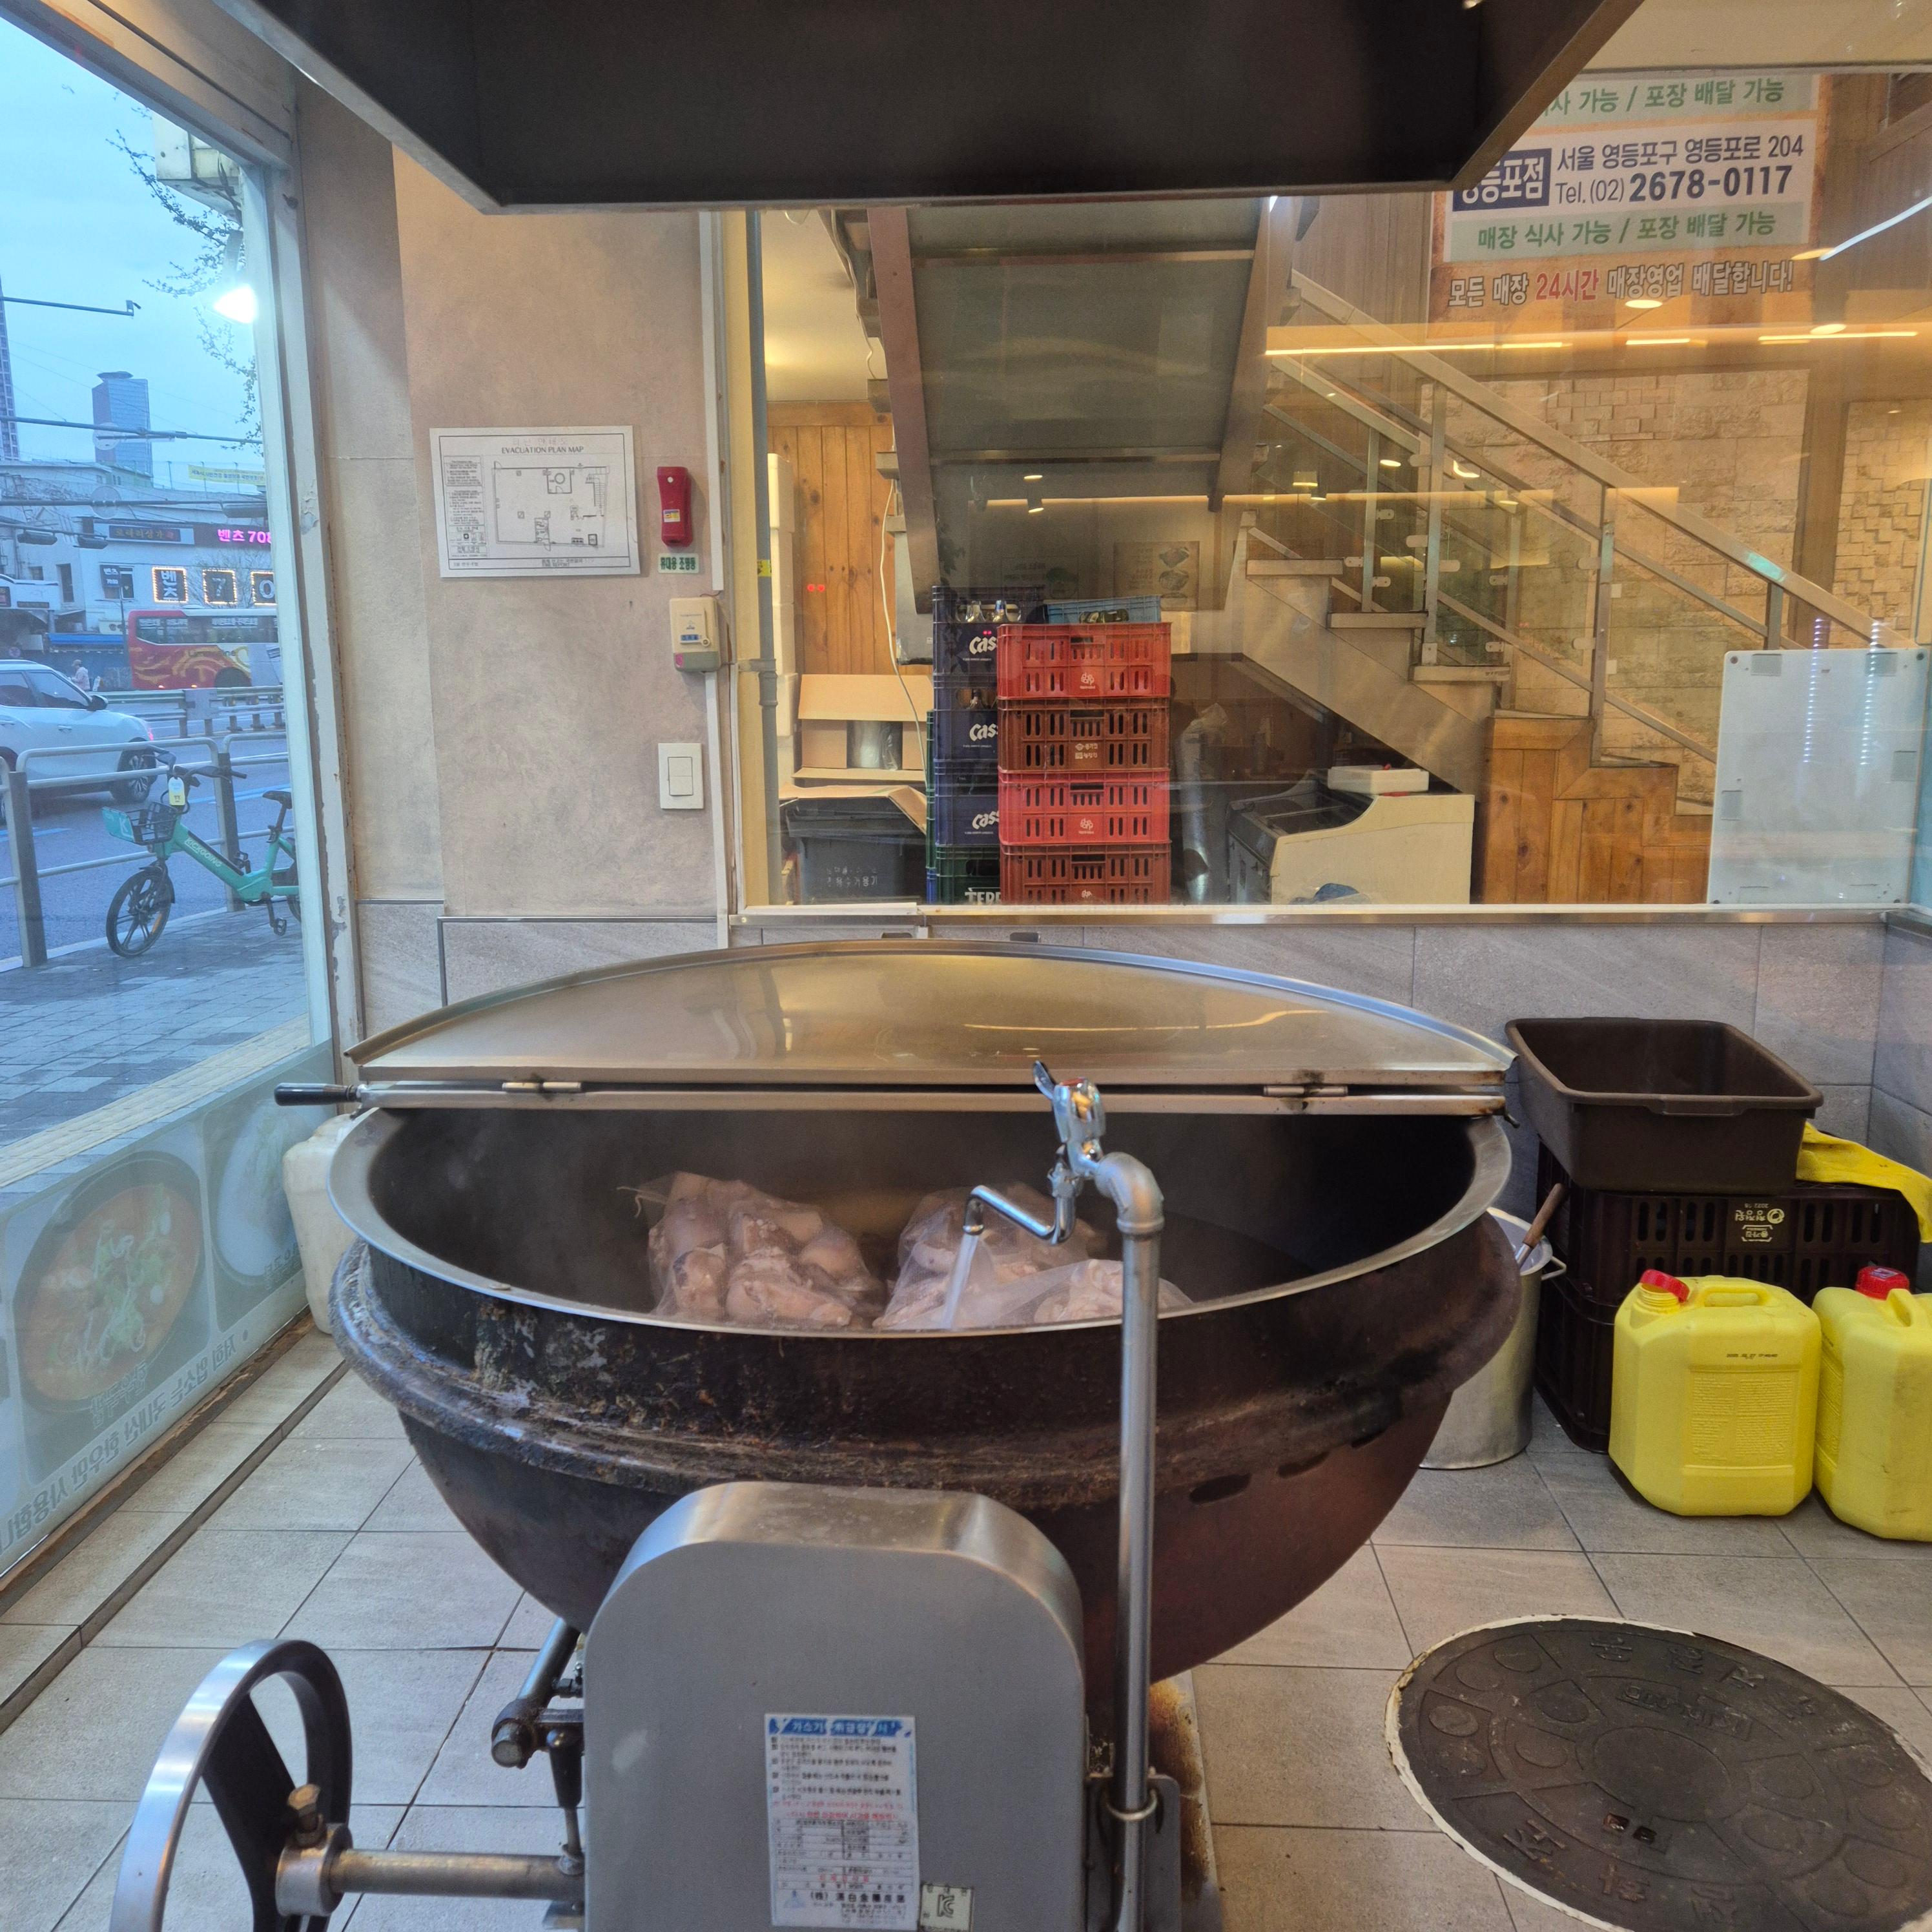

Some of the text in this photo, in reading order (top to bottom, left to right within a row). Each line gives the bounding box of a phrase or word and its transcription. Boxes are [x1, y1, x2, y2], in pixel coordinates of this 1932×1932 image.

[1544, 77, 1784, 116] 사 가능 / 포장 배달 가능
[1557, 134, 1804, 171] 서울 영등포구 영등포로 204
[1629, 165, 1793, 203] 2678-0117
[1477, 211, 1776, 251] 매장 식사 가능 / 포장 배달 가능
[1448, 260, 1794, 308] 모든 매장 24시간 매장영업 배달합니다!
[218, 528, 245, 542] 벤츠
[969, 636, 998, 655] Cas
[969, 723, 998, 741] Cas
